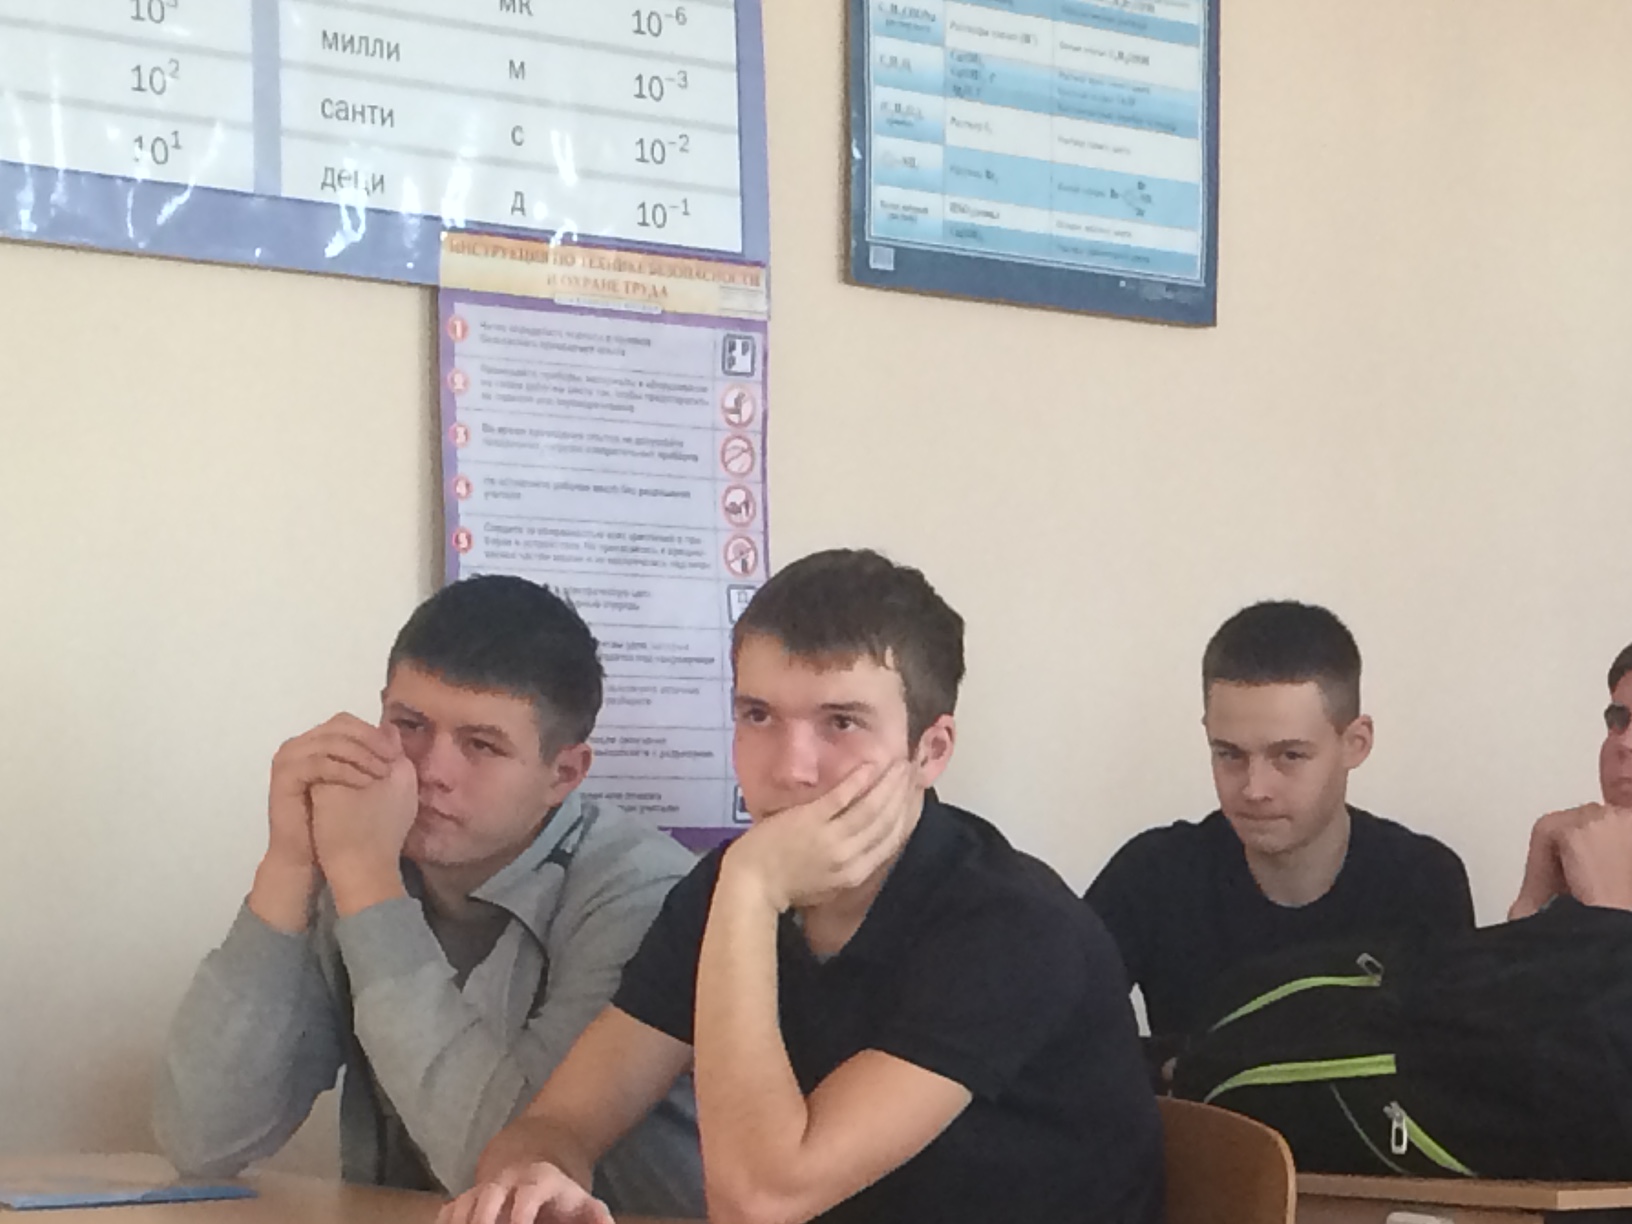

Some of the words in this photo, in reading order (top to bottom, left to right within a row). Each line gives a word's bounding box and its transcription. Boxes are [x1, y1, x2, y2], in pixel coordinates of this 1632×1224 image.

[321, 29, 401, 63] милли
[509, 59, 527, 80] м
[320, 98, 395, 129] санти
[510, 125, 525, 147] с
[510, 191, 527, 216] д
[560, 275, 619, 293] ОХРАНЕ
[624, 281, 669, 299] ТРУДА
